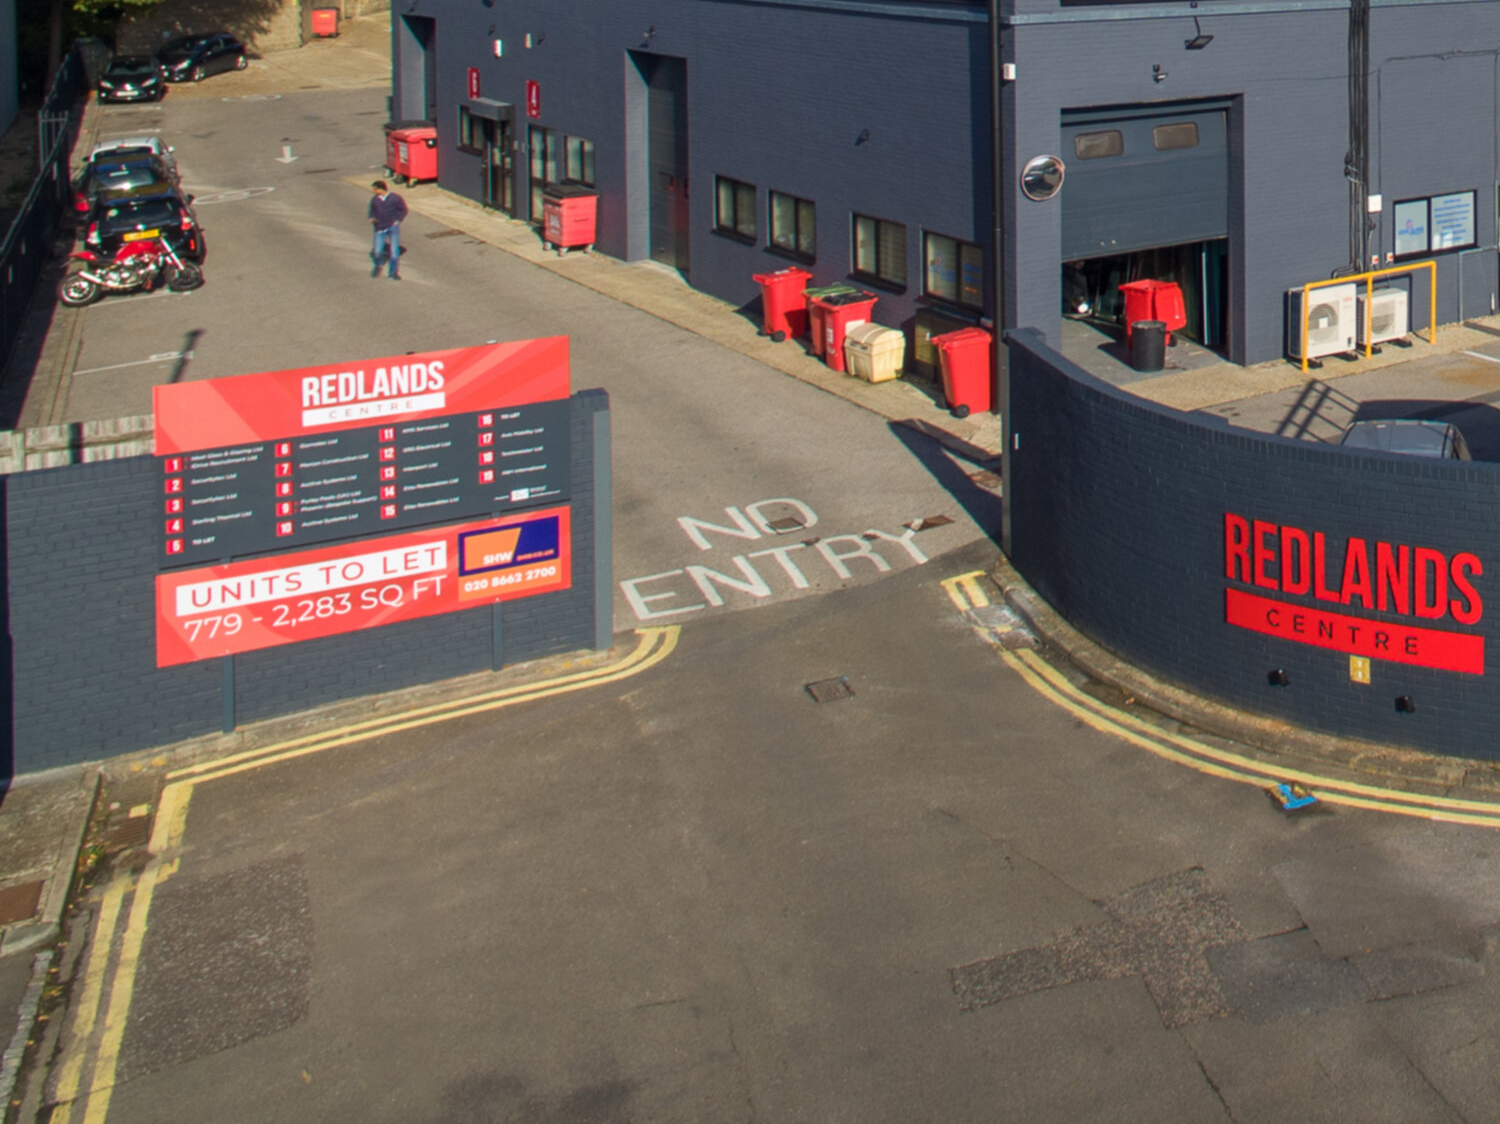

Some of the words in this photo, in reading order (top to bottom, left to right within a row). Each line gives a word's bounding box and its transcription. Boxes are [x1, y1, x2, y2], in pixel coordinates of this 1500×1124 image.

[302, 361, 444, 407] REDLANDS
[329, 400, 414, 419] CENTRE
[483, 414, 492, 425] 16
[384, 428, 394, 439] 11
[483, 433, 492, 444] 17
[281, 444, 288, 454] 6
[384, 448, 394, 458] 12
[483, 452, 493, 462] 18
[173, 459, 178, 470] 1
[282, 463, 289, 474] 7
[384, 467, 395, 478] 13
[484, 470, 493, 481] 19
[172, 479, 180, 491] 2
[282, 483, 289, 494] 8
[385, 486, 395, 497] 14
[172, 500, 180, 511] 3
[282, 503, 289, 514] 9
[385, 505, 395, 516] 15
[172, 520, 180, 531] 4
[280, 522, 291, 533] 10
[676, 497, 818, 551] NO
[483, 551, 513, 565] SHW
[620, 518, 929, 620] ENTRY
[1225, 511, 1483, 625] REDLANDS
[192, 572, 302, 608] UNITS
[320, 562, 364, 585] TO
[383, 547, 442, 574] LET
[465, 580, 488, 592] 020
[491, 573, 522, 587] 8662
[526, 566, 556, 580] 2700
[184, 614, 242, 642] 779
[272, 593, 351, 628] 2,283
[361, 584, 403, 610] SQ
[413, 575, 447, 600] FT
[1266, 609, 1418, 655] CENTRE
